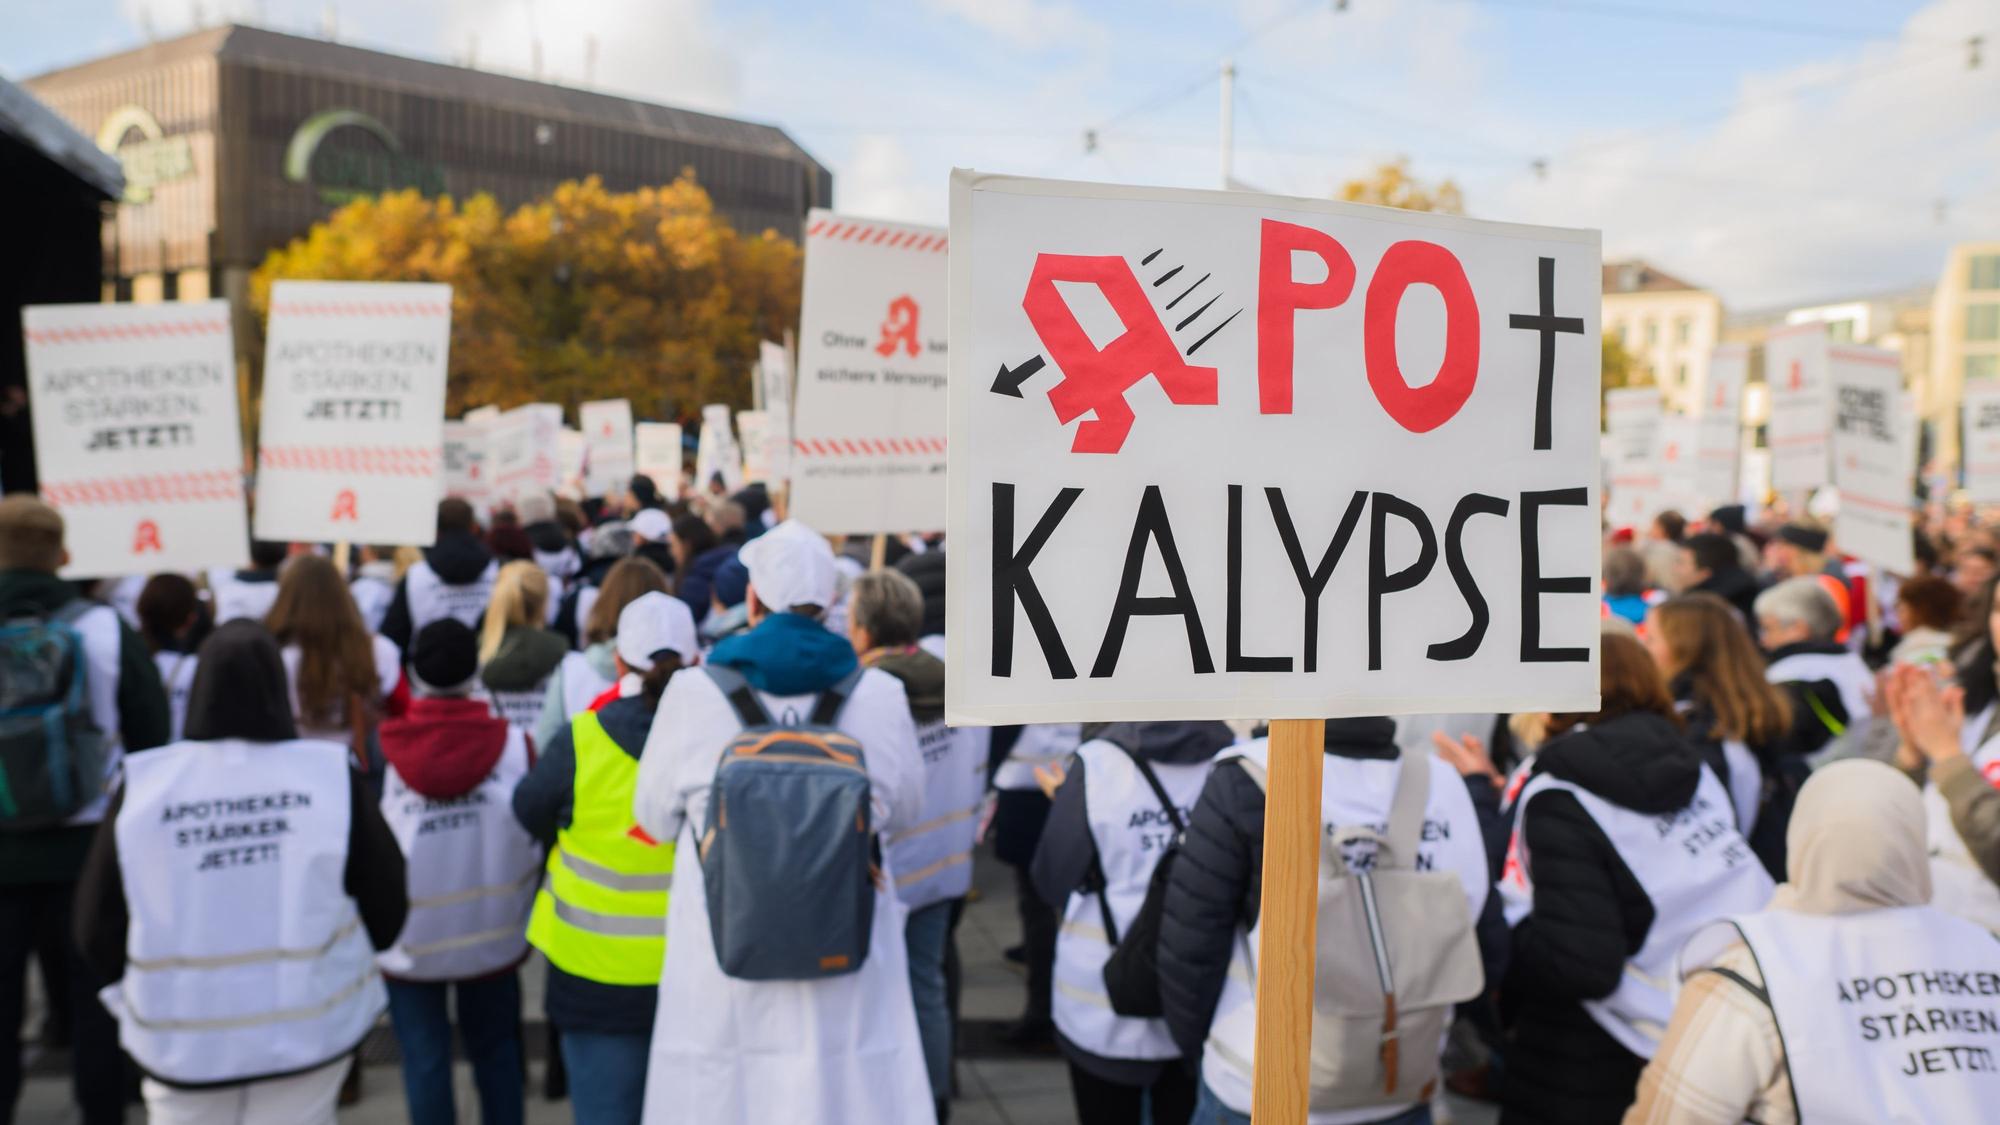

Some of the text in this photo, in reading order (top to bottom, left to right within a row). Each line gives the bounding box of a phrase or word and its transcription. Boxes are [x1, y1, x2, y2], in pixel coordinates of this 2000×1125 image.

[822, 331, 866, 348] Ohne
[817, 366, 876, 383] sichere
[991, 482, 1592, 680] KALYPSE
[161, 791, 312, 822] APOTHEKEN
[197, 843, 280, 872] JETZT!
